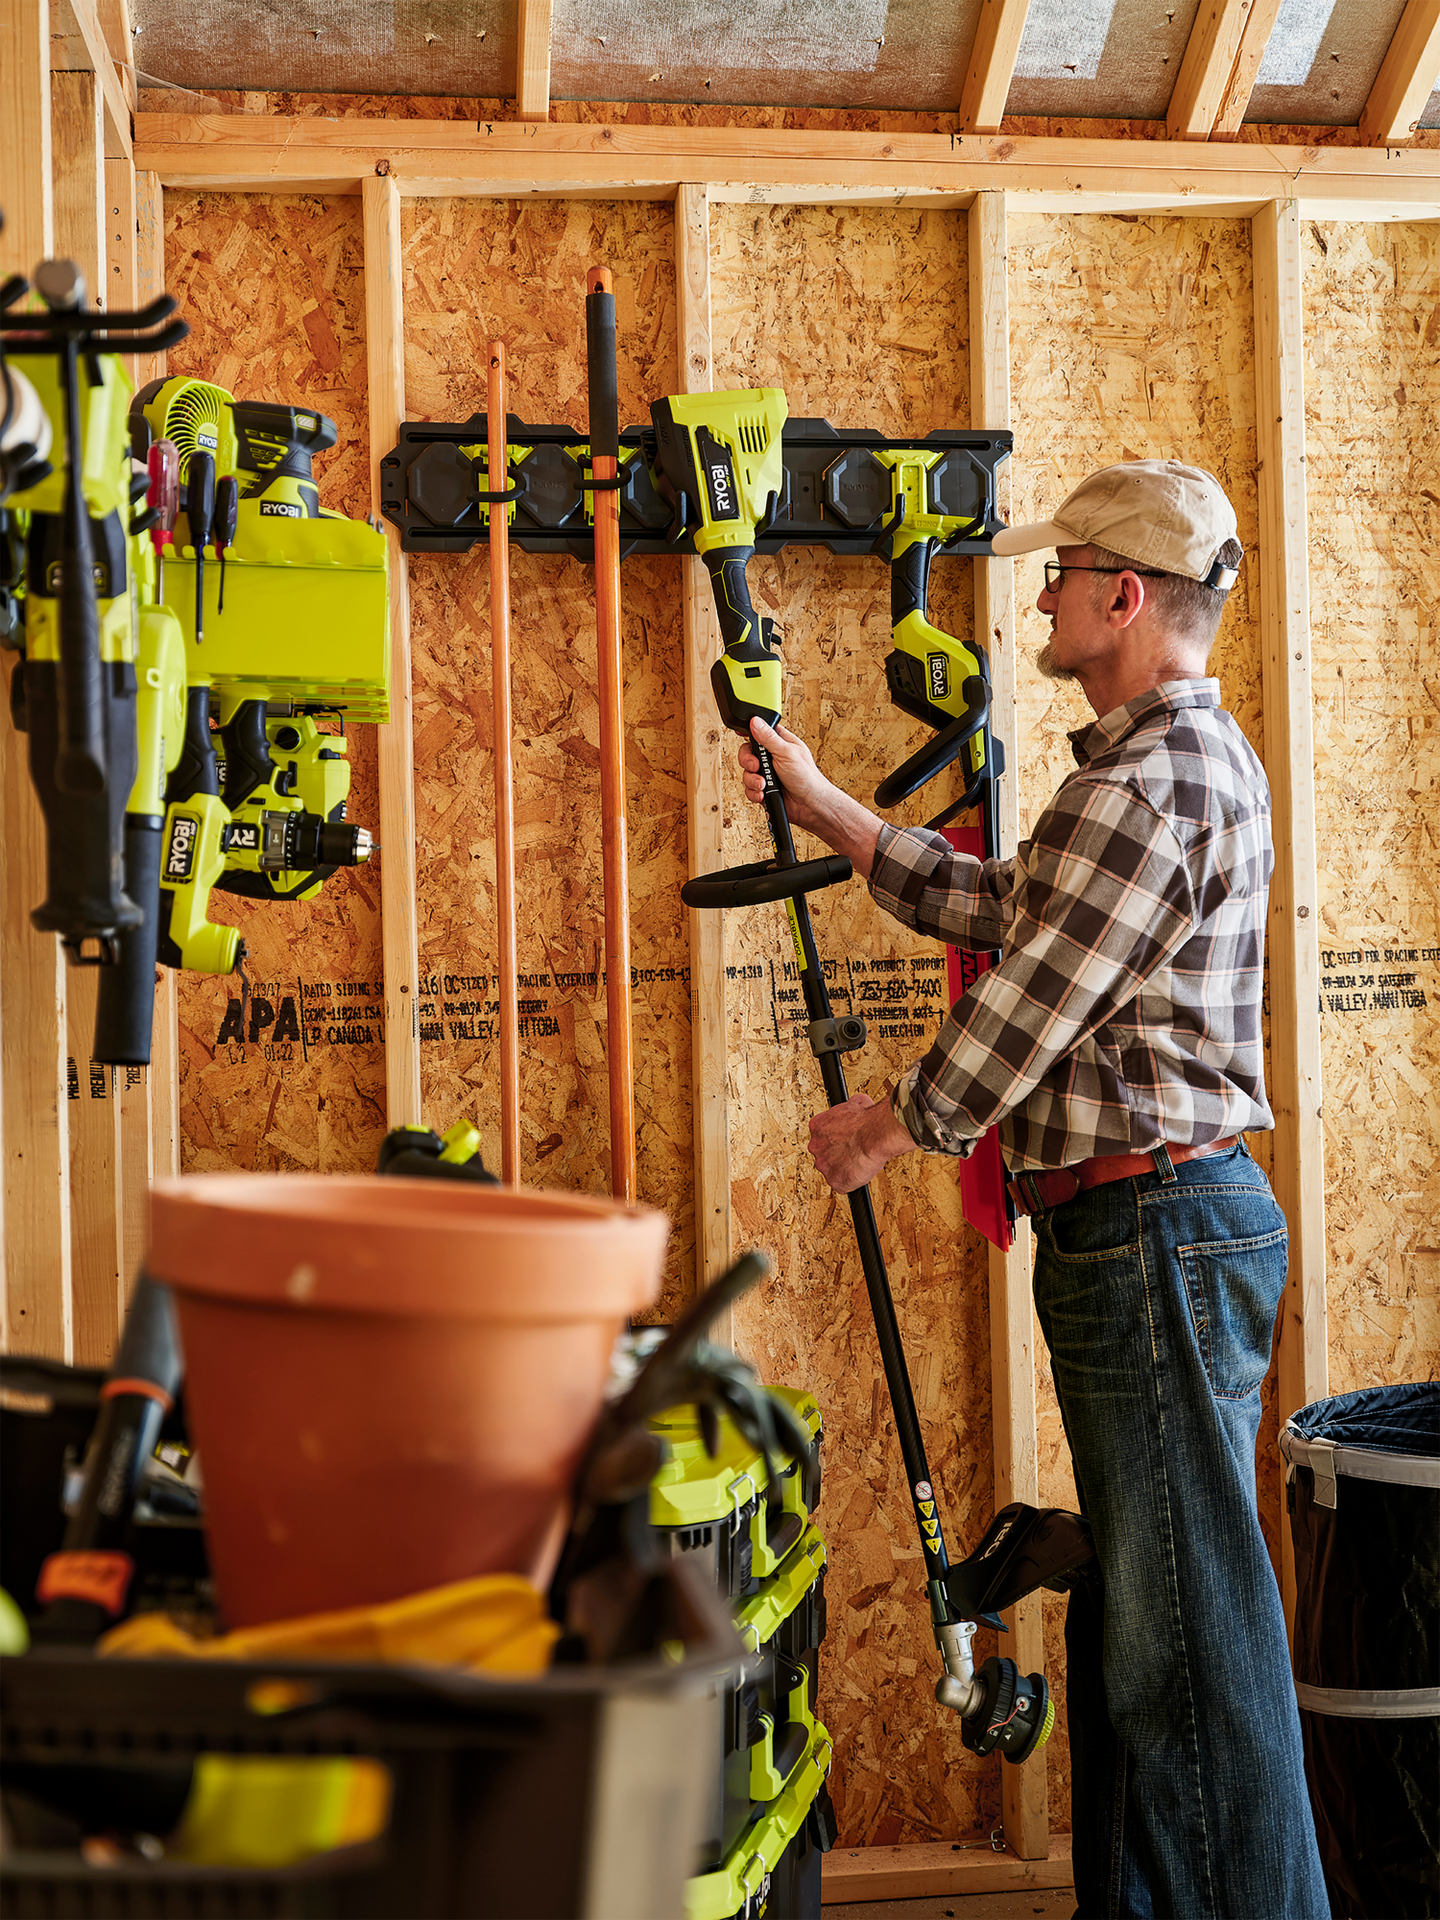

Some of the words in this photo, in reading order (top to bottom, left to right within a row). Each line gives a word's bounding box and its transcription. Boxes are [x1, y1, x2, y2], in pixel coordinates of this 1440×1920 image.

[199, 434, 218, 448] RYOB
[711, 464, 730, 511] RYOBI
[262, 503, 299, 519] RYOBI
[932, 658, 944, 695] RYOBI
[758, 743, 773, 786] BRUSHLE
[229, 829, 256, 846] RY
[168, 820, 191, 873] RYOBI
[1337, 951, 1362, 965] SIZED
[1365, 950, 1381, 963] FOR
[1384, 949, 1419, 963] SPACING
[1422, 948, 1440, 961] EXTE
[852, 961, 867, 973] APA
[870, 959, 905, 972] PRODUCT
[911, 958, 945, 971] SUPPORT
[460, 976, 488, 990] SIZED
[517, 974, 551, 988] PACING
[554, 972, 598, 987] EXTERIOR
[640, 967, 690, 983] ICC-ESR-13
[303, 983, 332, 998] RATED
[336, 982, 370, 996] SIDING
[217, 996, 300, 1045] APA
[306, 1026, 321, 1046] LP
[327, 1025, 374, 1045] CANADA
[879, 1024, 925, 1038] DIRECTION
[979, 1522, 1013, 1561] OBI
